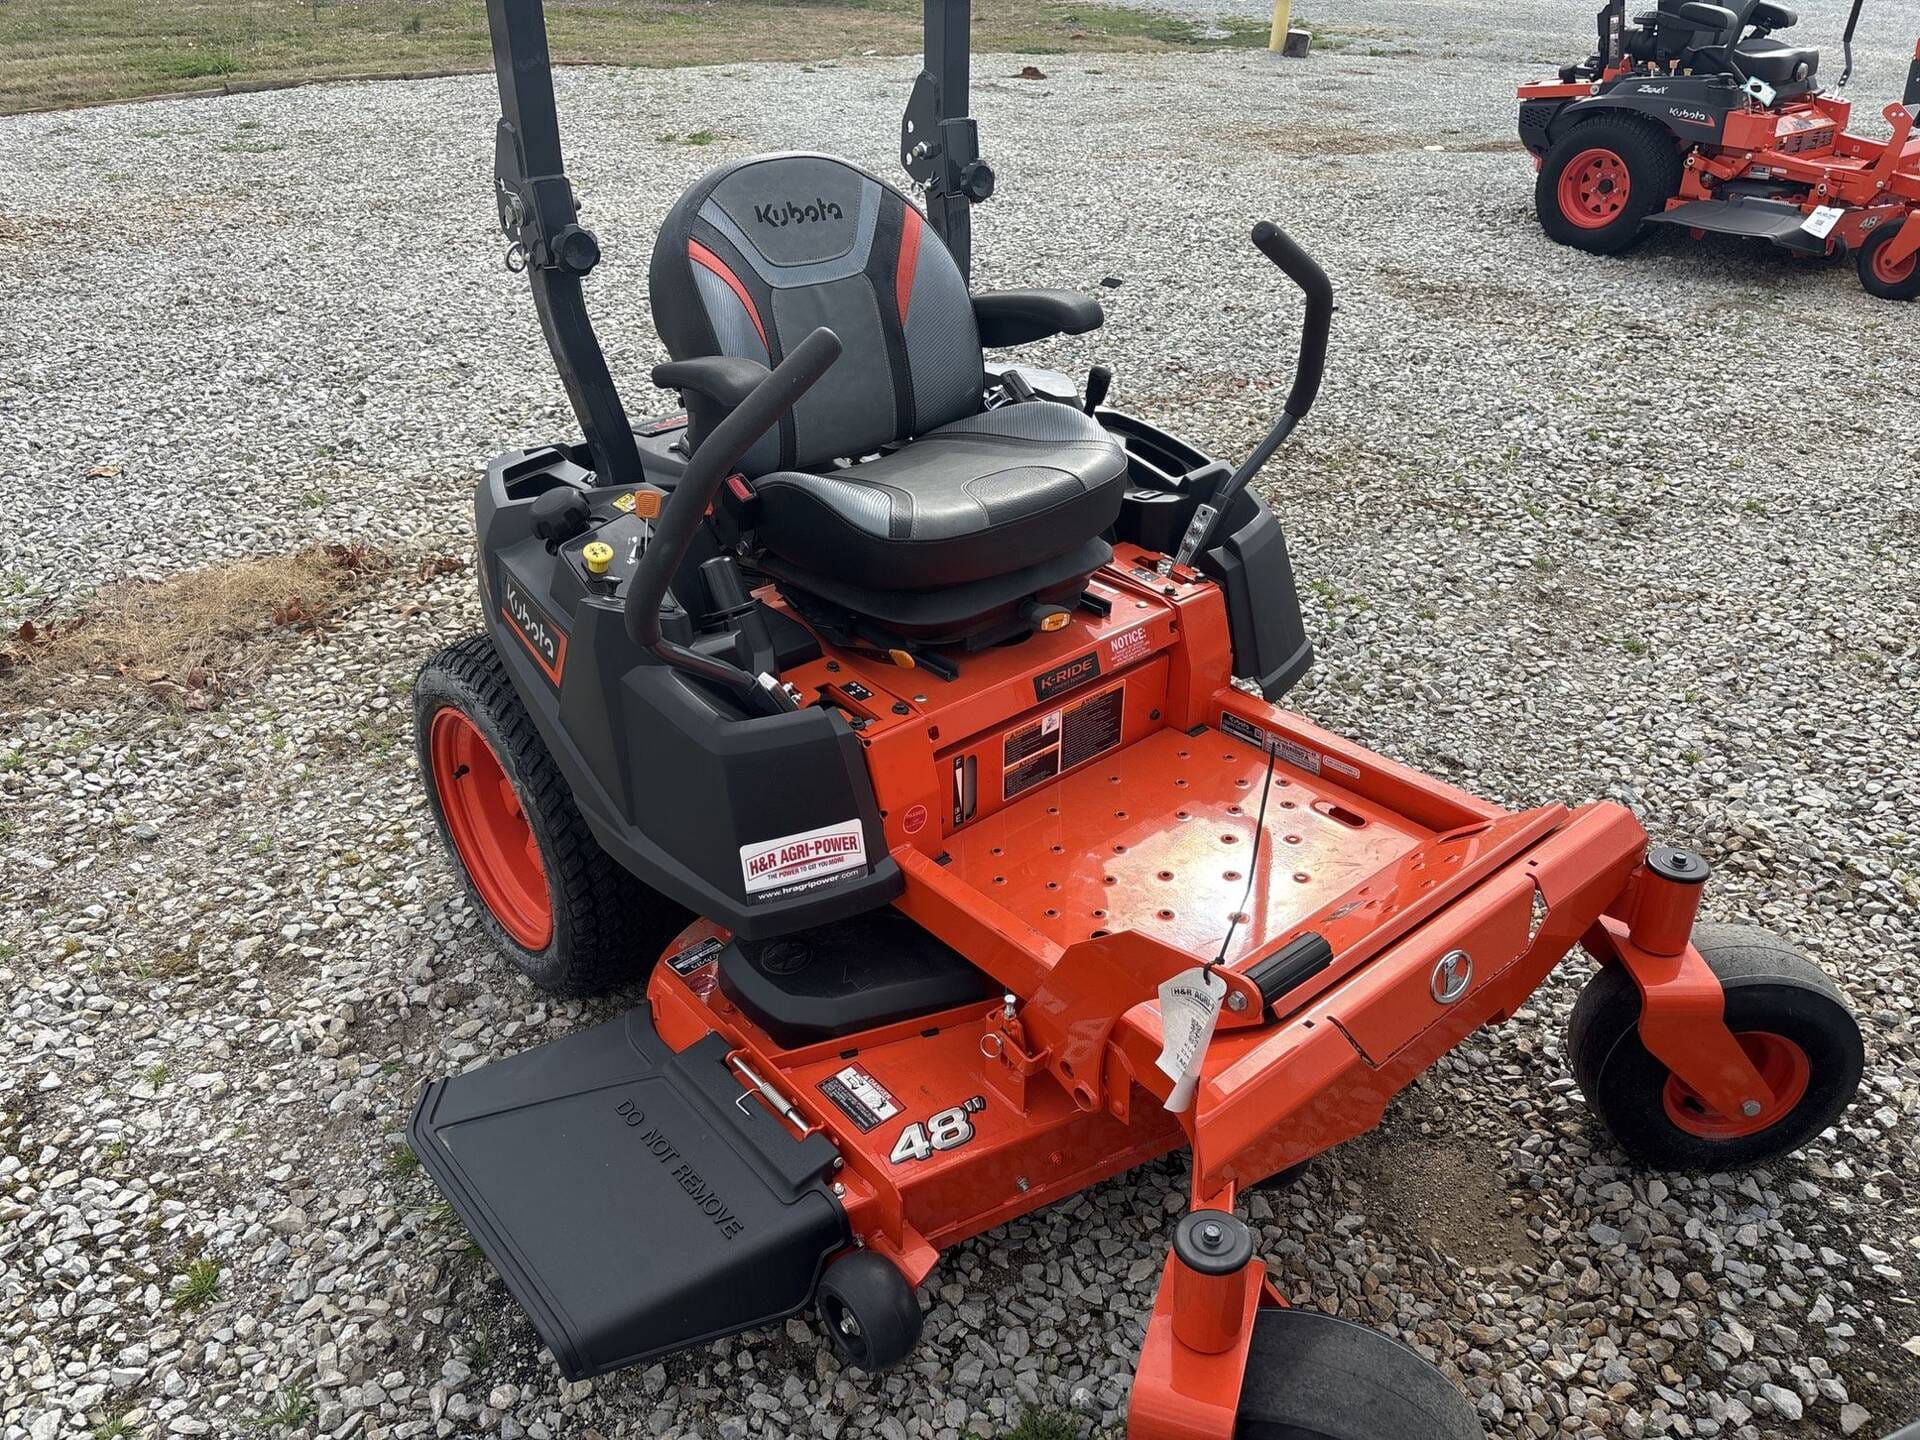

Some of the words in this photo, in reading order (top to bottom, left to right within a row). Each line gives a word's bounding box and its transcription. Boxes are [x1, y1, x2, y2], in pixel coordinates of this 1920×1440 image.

[1669, 107, 1706, 121] Kubota
[753, 198, 844, 228] Kubota
[506, 582, 556, 660] Kubota
[1110, 627, 1147, 653] NOTICE:
[1041, 659, 1094, 690] K-RIDE
[750, 853, 777, 876] H&R
[780, 835, 858, 864] AGRI-POWER
[758, 869, 859, 901] www.hragripower.com
[778, 868, 800, 879] POWER
[615, 1099, 645, 1127] DO
[640, 1128, 681, 1163] NOT
[671, 1162, 745, 1240] REMOVE
